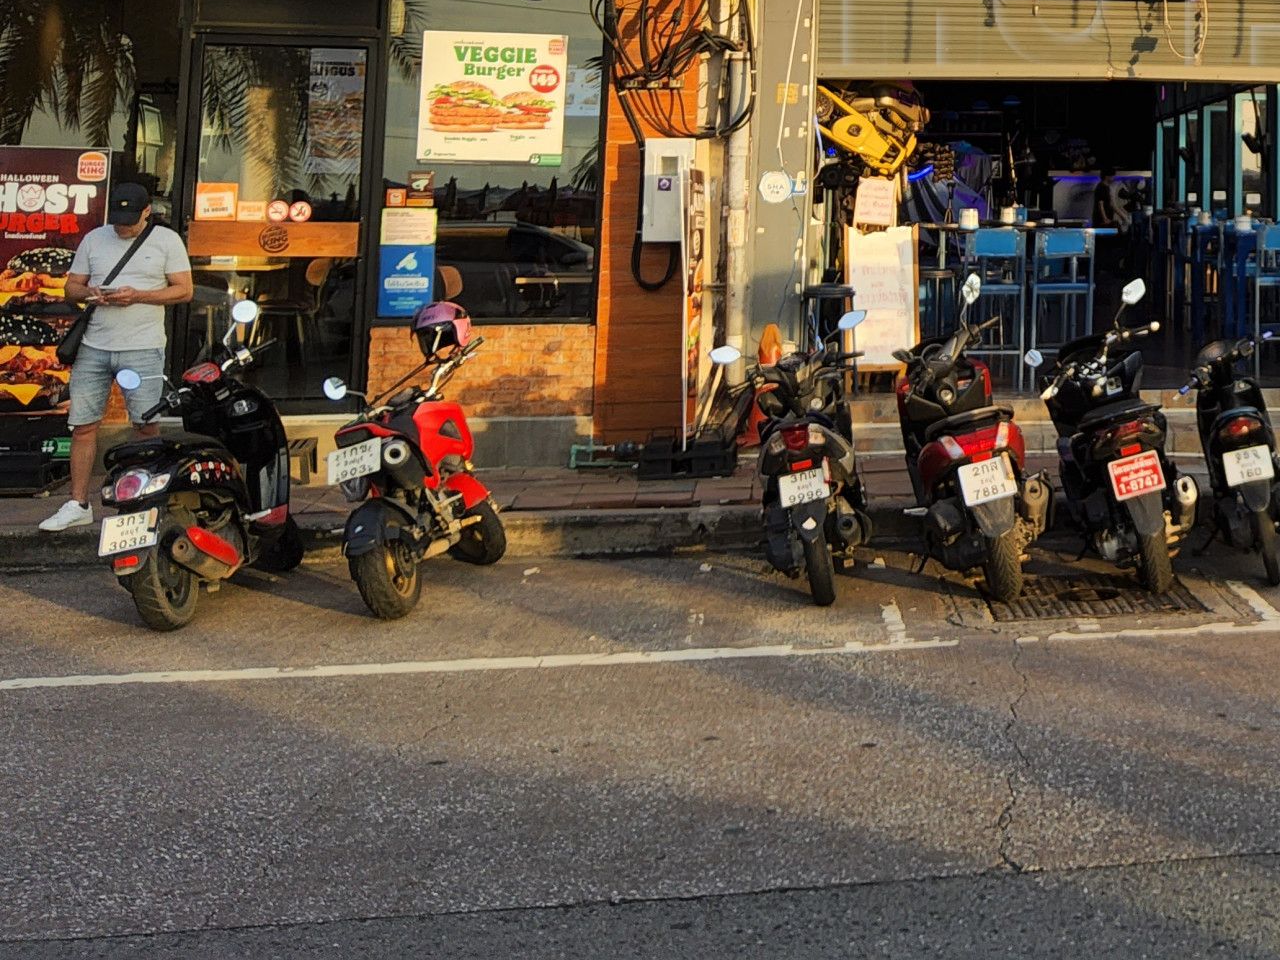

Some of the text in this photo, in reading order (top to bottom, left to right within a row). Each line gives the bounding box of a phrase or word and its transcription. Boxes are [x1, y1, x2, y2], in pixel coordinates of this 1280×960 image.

[454, 46, 537, 63] VEGGIE
[464, 64, 525, 80] Burger
[1, 174, 59, 182] HALLOWEEN
[80, 166, 105, 174] KING
[108, 535, 147, 551] 3038
